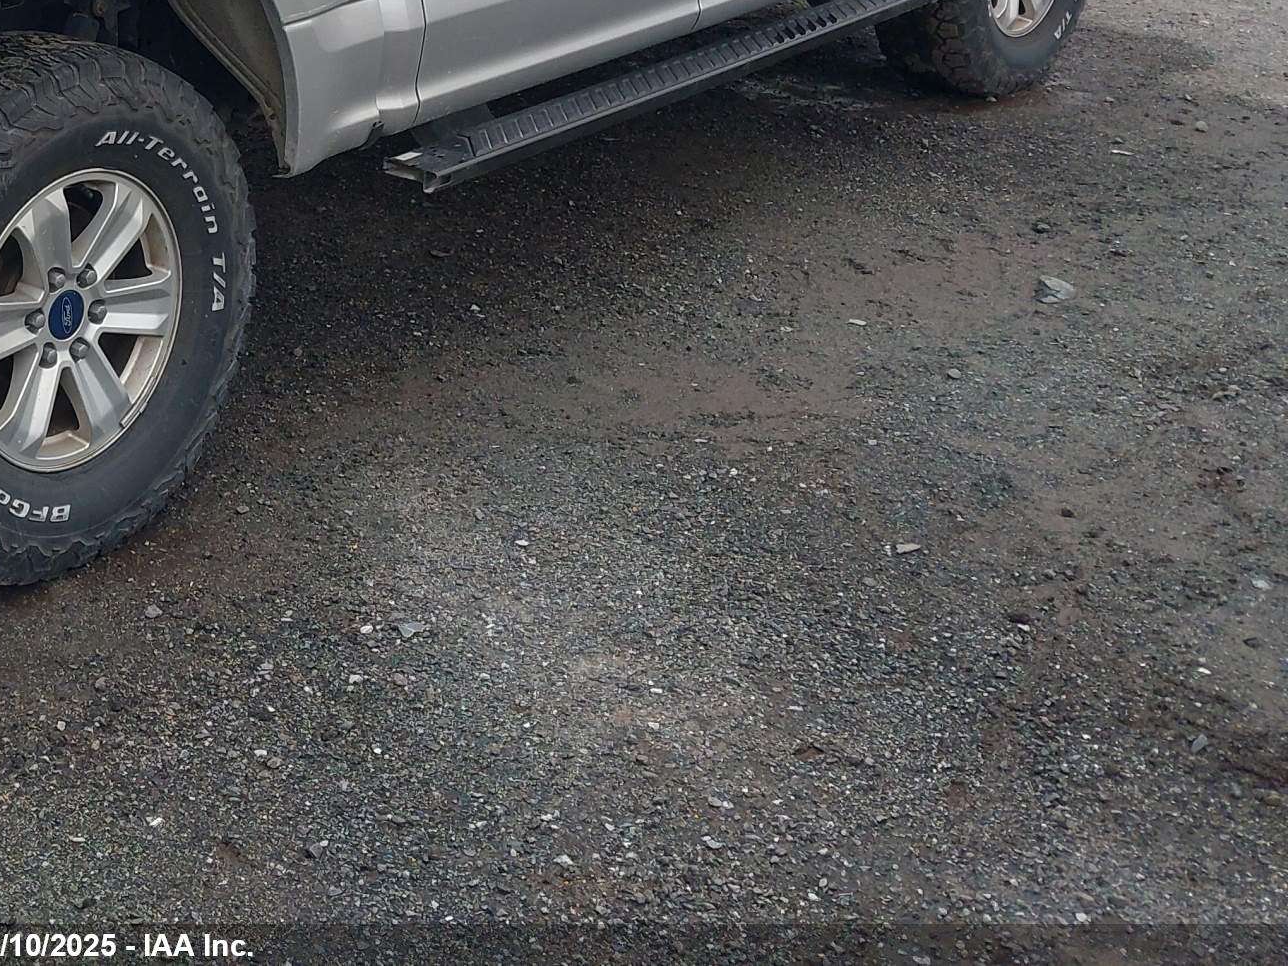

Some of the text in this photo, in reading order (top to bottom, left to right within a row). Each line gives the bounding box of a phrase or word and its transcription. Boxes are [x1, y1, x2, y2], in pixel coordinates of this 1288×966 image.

[1053, 12, 1073, 41] T/A
[95, 128, 230, 313] All-Terrain T/A
